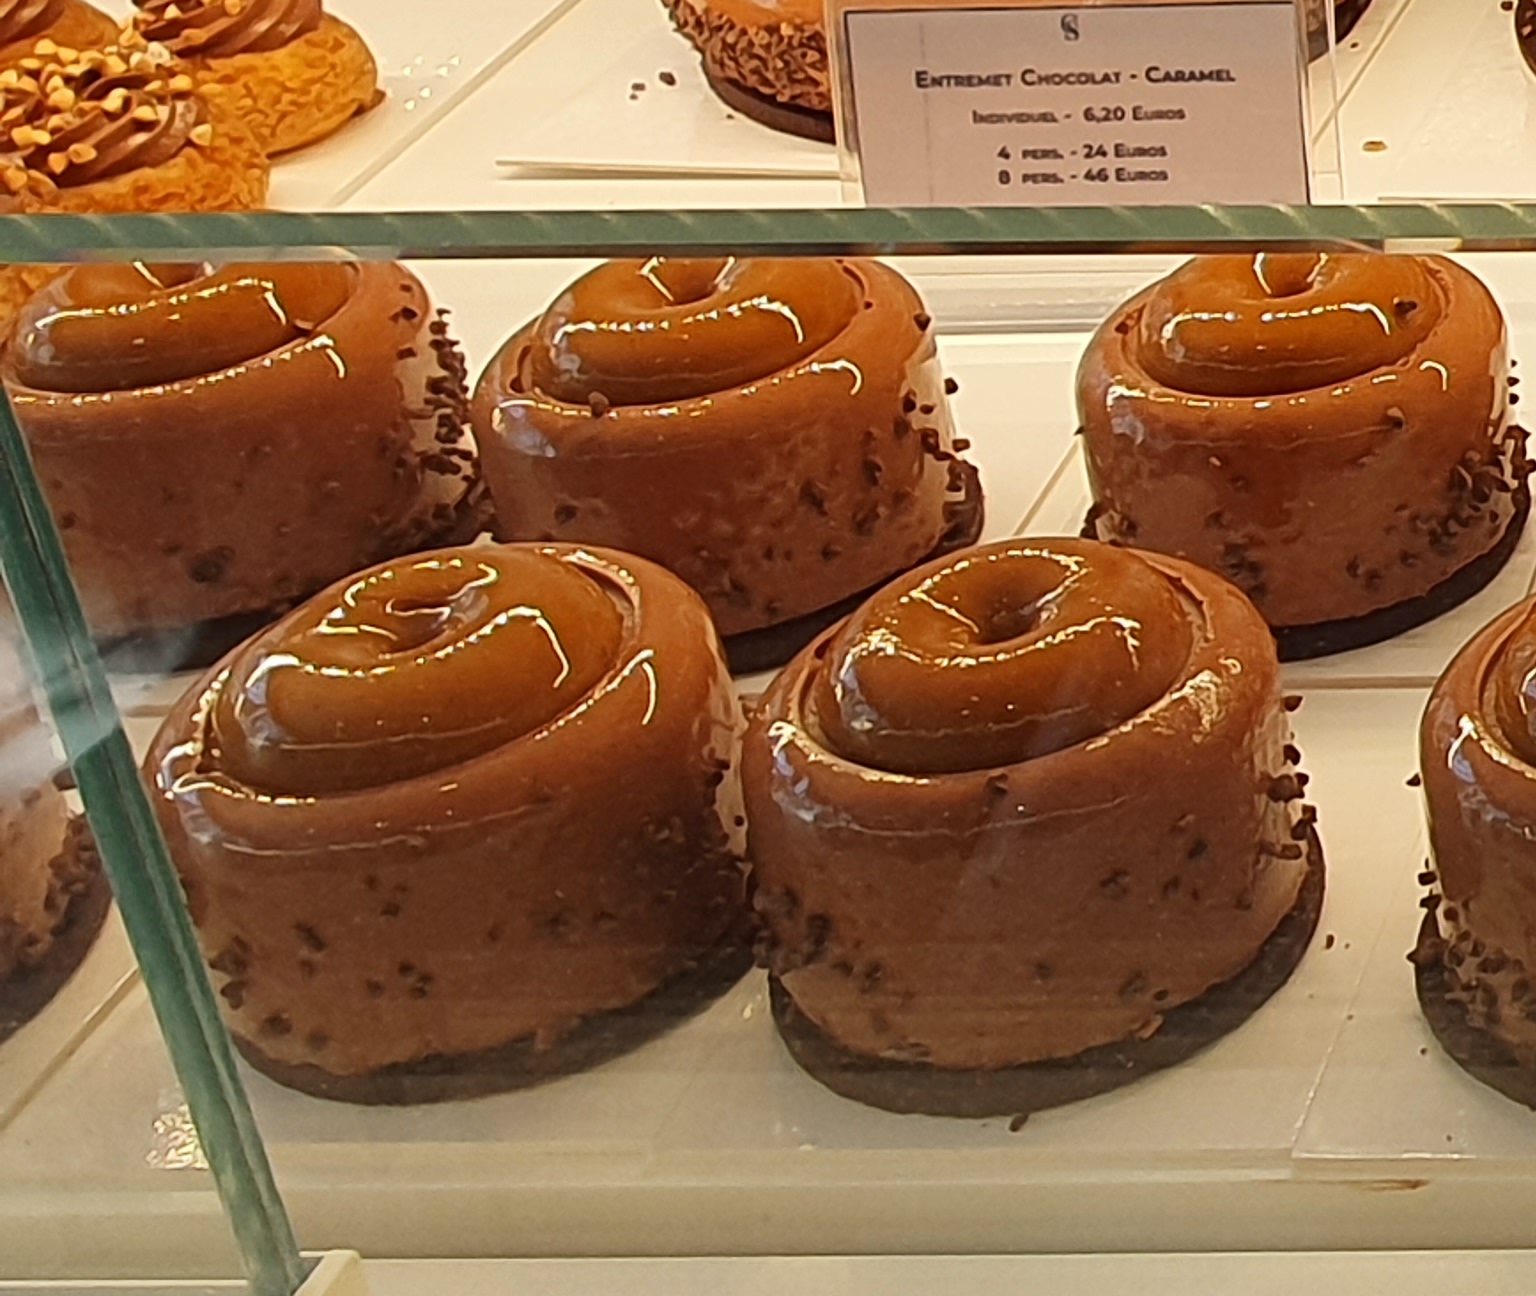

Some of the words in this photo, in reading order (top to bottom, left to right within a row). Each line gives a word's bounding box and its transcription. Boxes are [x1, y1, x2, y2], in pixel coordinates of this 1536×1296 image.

[1083, 106, 1126, 124] 6,20
[996, 145, 1011, 160] 4
[1082, 143, 1108, 159] 24
[1083, 167, 1110, 183] 46
